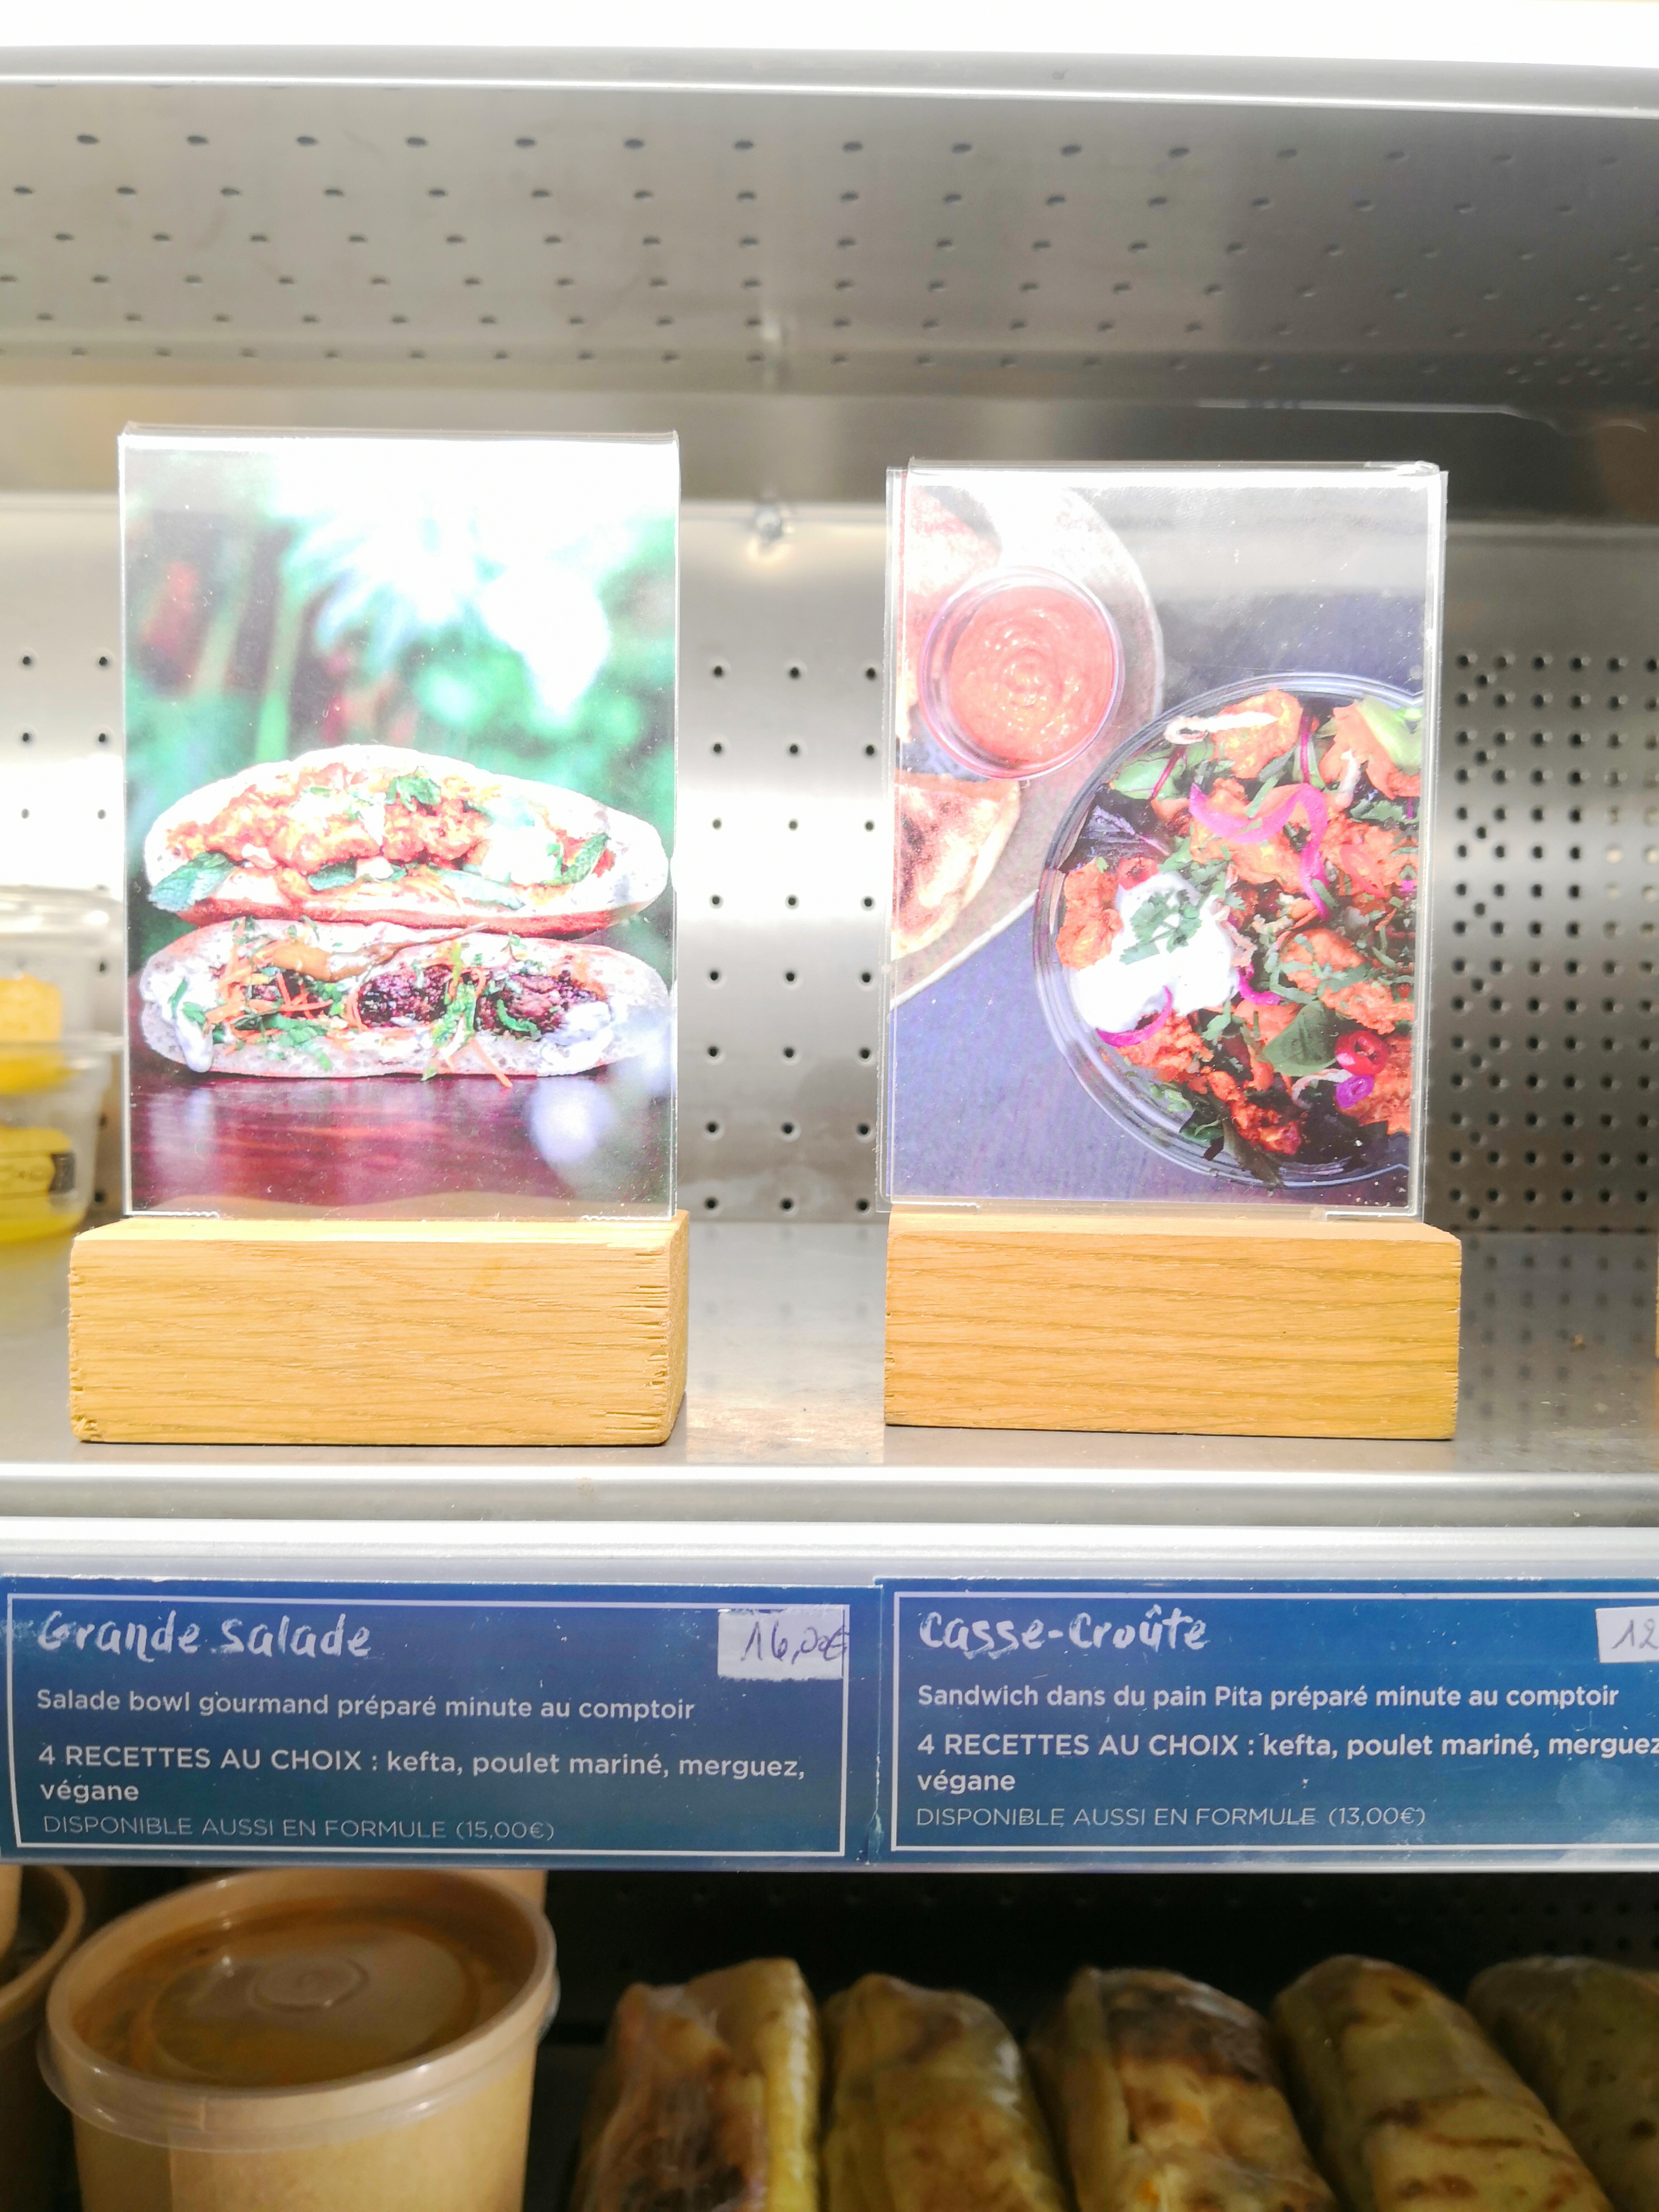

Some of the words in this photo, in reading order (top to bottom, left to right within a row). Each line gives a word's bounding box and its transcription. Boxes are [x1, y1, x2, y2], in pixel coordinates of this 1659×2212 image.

[37, 1610, 202, 1662] Grande
[919, 1604, 1210, 1660] Casse-Croûte
[37, 1689, 120, 1711] Salade
[129, 1691, 190, 1712] bowl
[200, 1694, 328, 1716] gourmand
[338, 1695, 436, 1718] préparé
[446, 1697, 532, 1717] minute
[541, 1701, 570, 1717] au
[579, 1700, 695, 1723] comptoir
[918, 1685, 1038, 1706] Sandwich
[1047, 1687, 1105, 1706] dans
[1114, 1686, 1145, 1706] du
[1154, 1686, 1206, 1709] pain
[1215, 1686, 1262, 1706] Pita
[1270, 1685, 1367, 1710] préparé
[1375, 1686, 1460, 1705] minute
[1469, 1690, 1497, 1705] au
[1506, 1685, 1619, 1710] comptoir
[918, 1735, 934, 1755] 4
[944, 1734, 1089, 1756] RECETTES
[1098, 1735, 1139, 1756] AU
[1148, 1734, 1238, 1756] CHOIX
[1248, 1739, 1254, 1755] :
[1263, 1734, 1338, 1758] kefta,
[1347, 1734, 1433, 1759] poulet
[1442, 1733, 1540, 1758] mariné,
[38, 1745, 56, 1765] 4
[66, 1745, 211, 1768] RECETTES
[221, 1749, 261, 1769] AU
[271, 1750, 361, 1770] CHOIX
[371, 1755, 378, 1772] :
[387, 1751, 463, 1776] kefta,
[473, 1753, 560, 1776] poulet
[569, 1755, 668, 1777] mariné,
[679, 1758, 805, 1781] merguez,
[40, 1779, 139, 1802] végane
[917, 1770, 1015, 1794] végane
[44, 1815, 193, 1835] DISPONIBLE
[202, 1818, 273, 1836] AUSSI
[284, 1820, 317, 1837] EN
[324, 1821, 445, 1839] FORMULE
[456, 1821, 555, 1841] (15,00€)
[917, 1807, 1064, 1826] DISPONIBLE
[1073, 1807, 1146, 1826] AUSSI
[1155, 1808, 1187, 1826] EN
[1196, 1807, 1316, 1826] FORMULE
[1328, 1807, 1425, 1827] (13,00€)
